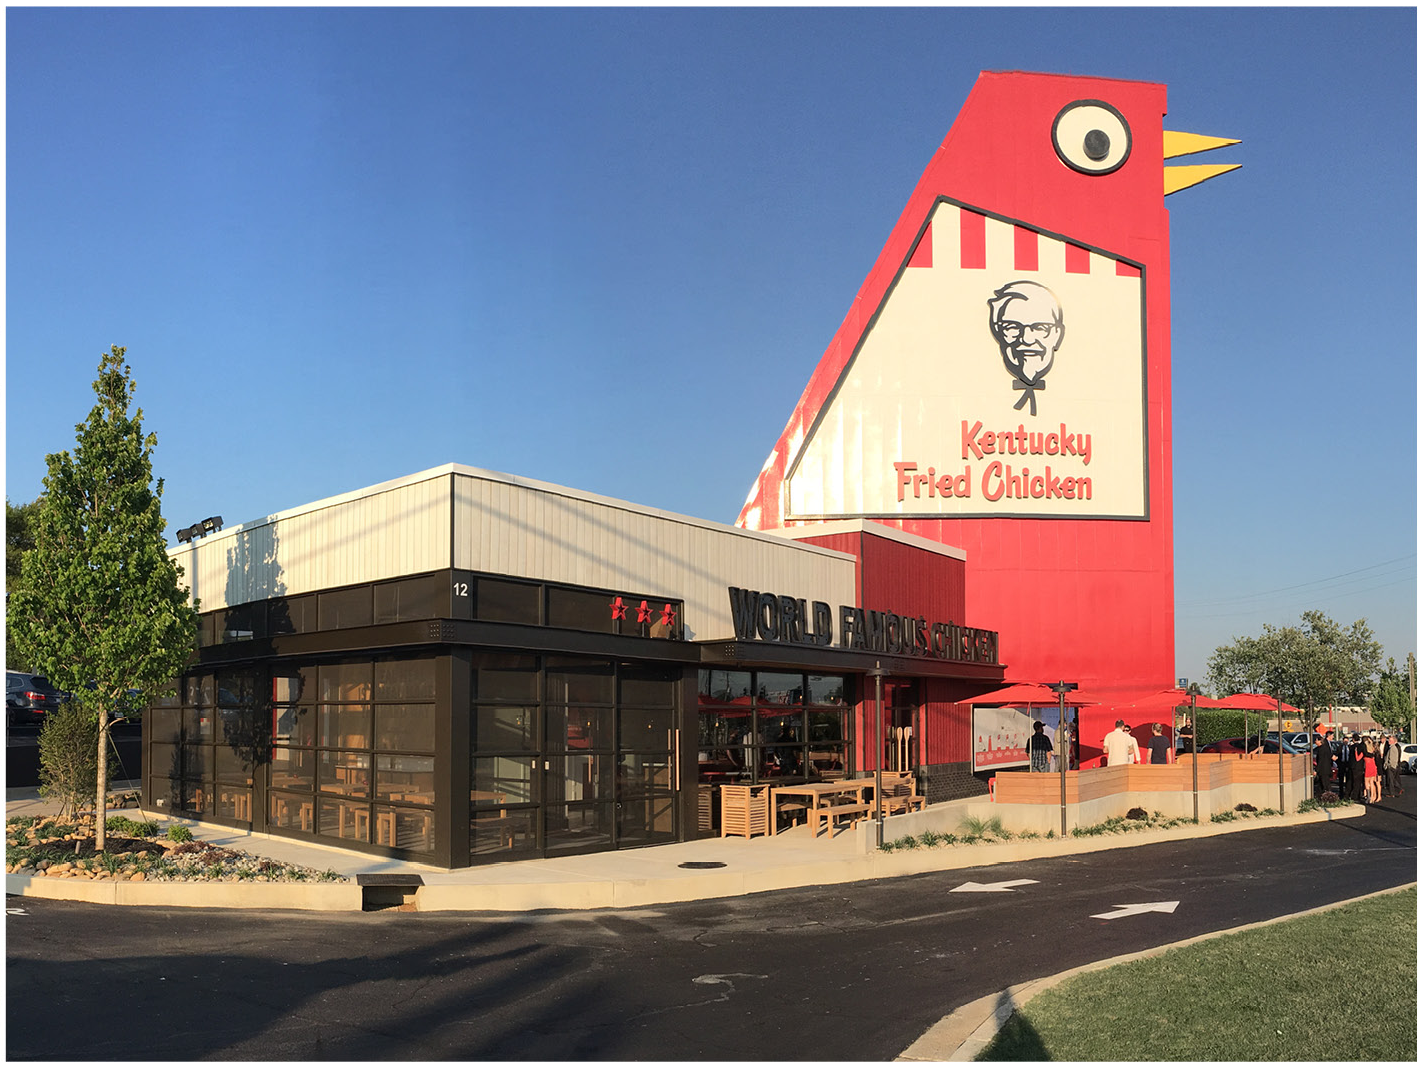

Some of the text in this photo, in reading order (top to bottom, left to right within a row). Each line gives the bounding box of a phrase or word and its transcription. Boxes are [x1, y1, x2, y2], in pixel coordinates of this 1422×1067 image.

[961, 420, 1092, 466] Kentucky
[893, 460, 1092, 502] Fried Chicken
[454, 583, 468, 596] 12
[728, 586, 999, 664] WORLD FAMOUS CHICKEN
